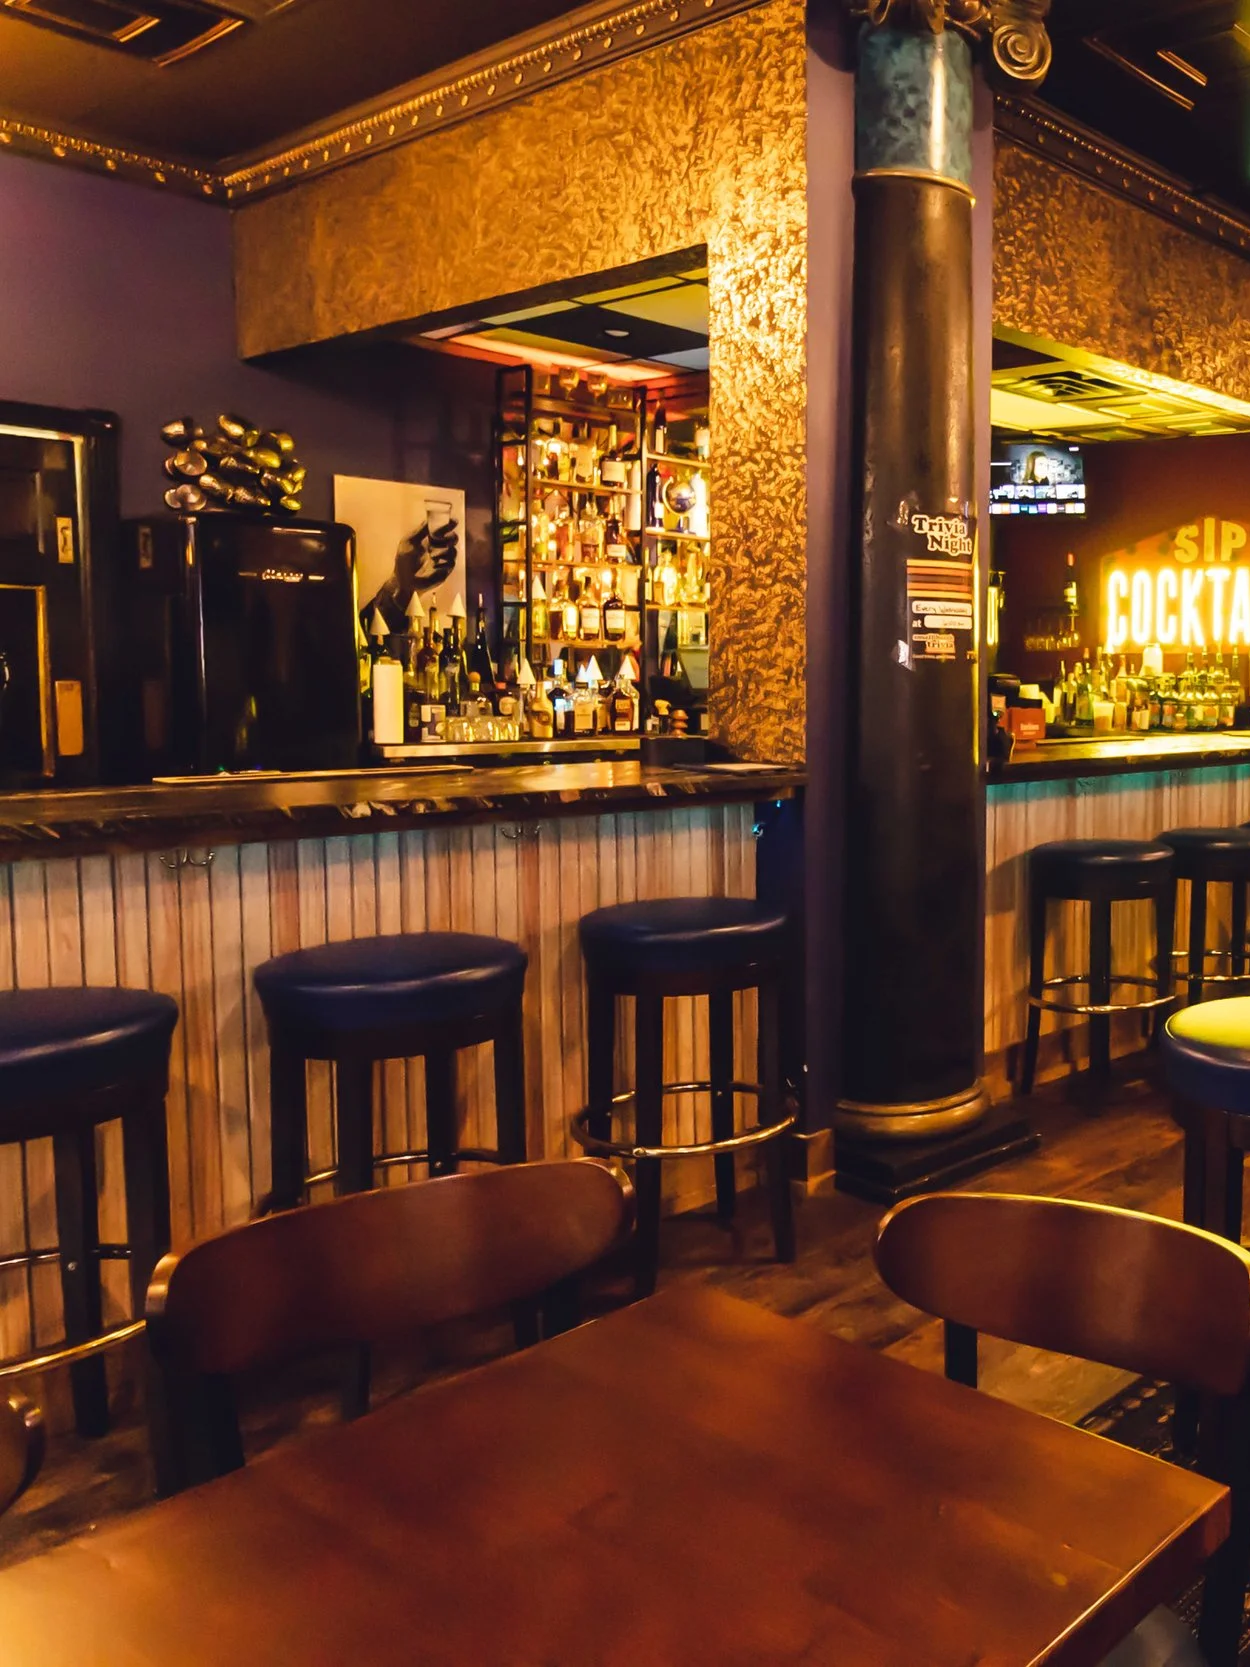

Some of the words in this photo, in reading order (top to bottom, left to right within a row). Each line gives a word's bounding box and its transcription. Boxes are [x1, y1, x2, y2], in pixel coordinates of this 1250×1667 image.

[912, 516, 966, 536] Trivia
[928, 535, 972, 555] Night
[1174, 517, 1247, 563] SIP
[915, 603, 937, 613] Every
[912, 619, 922, 628] at
[927, 640, 954, 649] trivia
